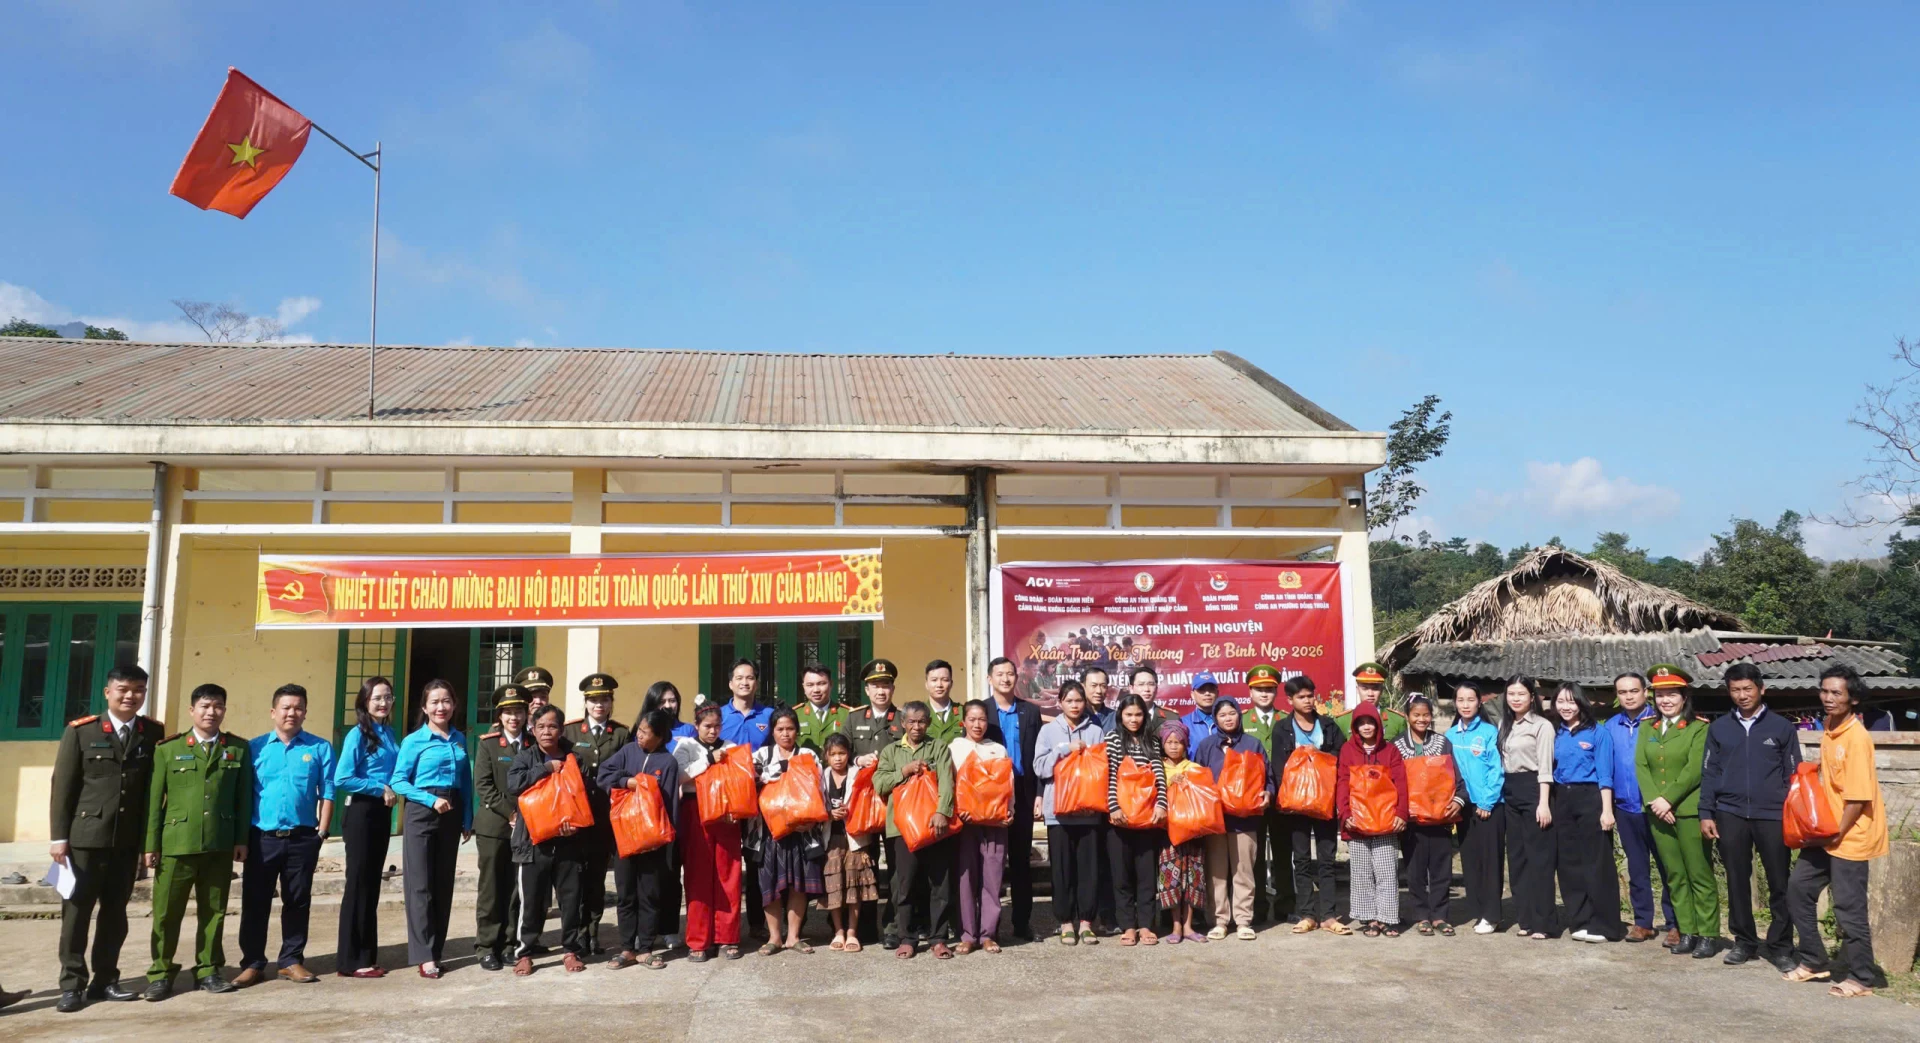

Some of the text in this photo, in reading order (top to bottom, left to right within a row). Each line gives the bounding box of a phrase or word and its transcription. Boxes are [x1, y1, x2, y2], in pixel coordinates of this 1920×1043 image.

[334, 561, 847, 617] NHIỆT LIỆT CHÀO MỪNG ĐẠI HỘI ĐẠI BIỂU TOÀN QUỐC LẦN THỨ XIV CỦA ĐẢNG!
[1025, 576, 1054, 588] ACV
[1090, 619, 1263, 636] CHƯƠNG TRÌNH TÌNH NGUYỆN
[1029, 644, 1067, 661] Xuân
[1068, 644, 1101, 661] Trao
[1105, 645, 1129, 661] Yêu
[1131, 644, 1184, 665] Thương
[1200, 643, 1222, 659] Tết
[1223, 642, 1258, 659] Bính
[1260, 642, 1288, 662] Ngọ
[1291, 645, 1324, 658] 2026
[1167, 670, 1193, 688] LUẬT
[1212, 667, 1240, 684] XUẤT
[1168, 698, 1178, 706] 27
[1180, 698, 1196, 706] thán
